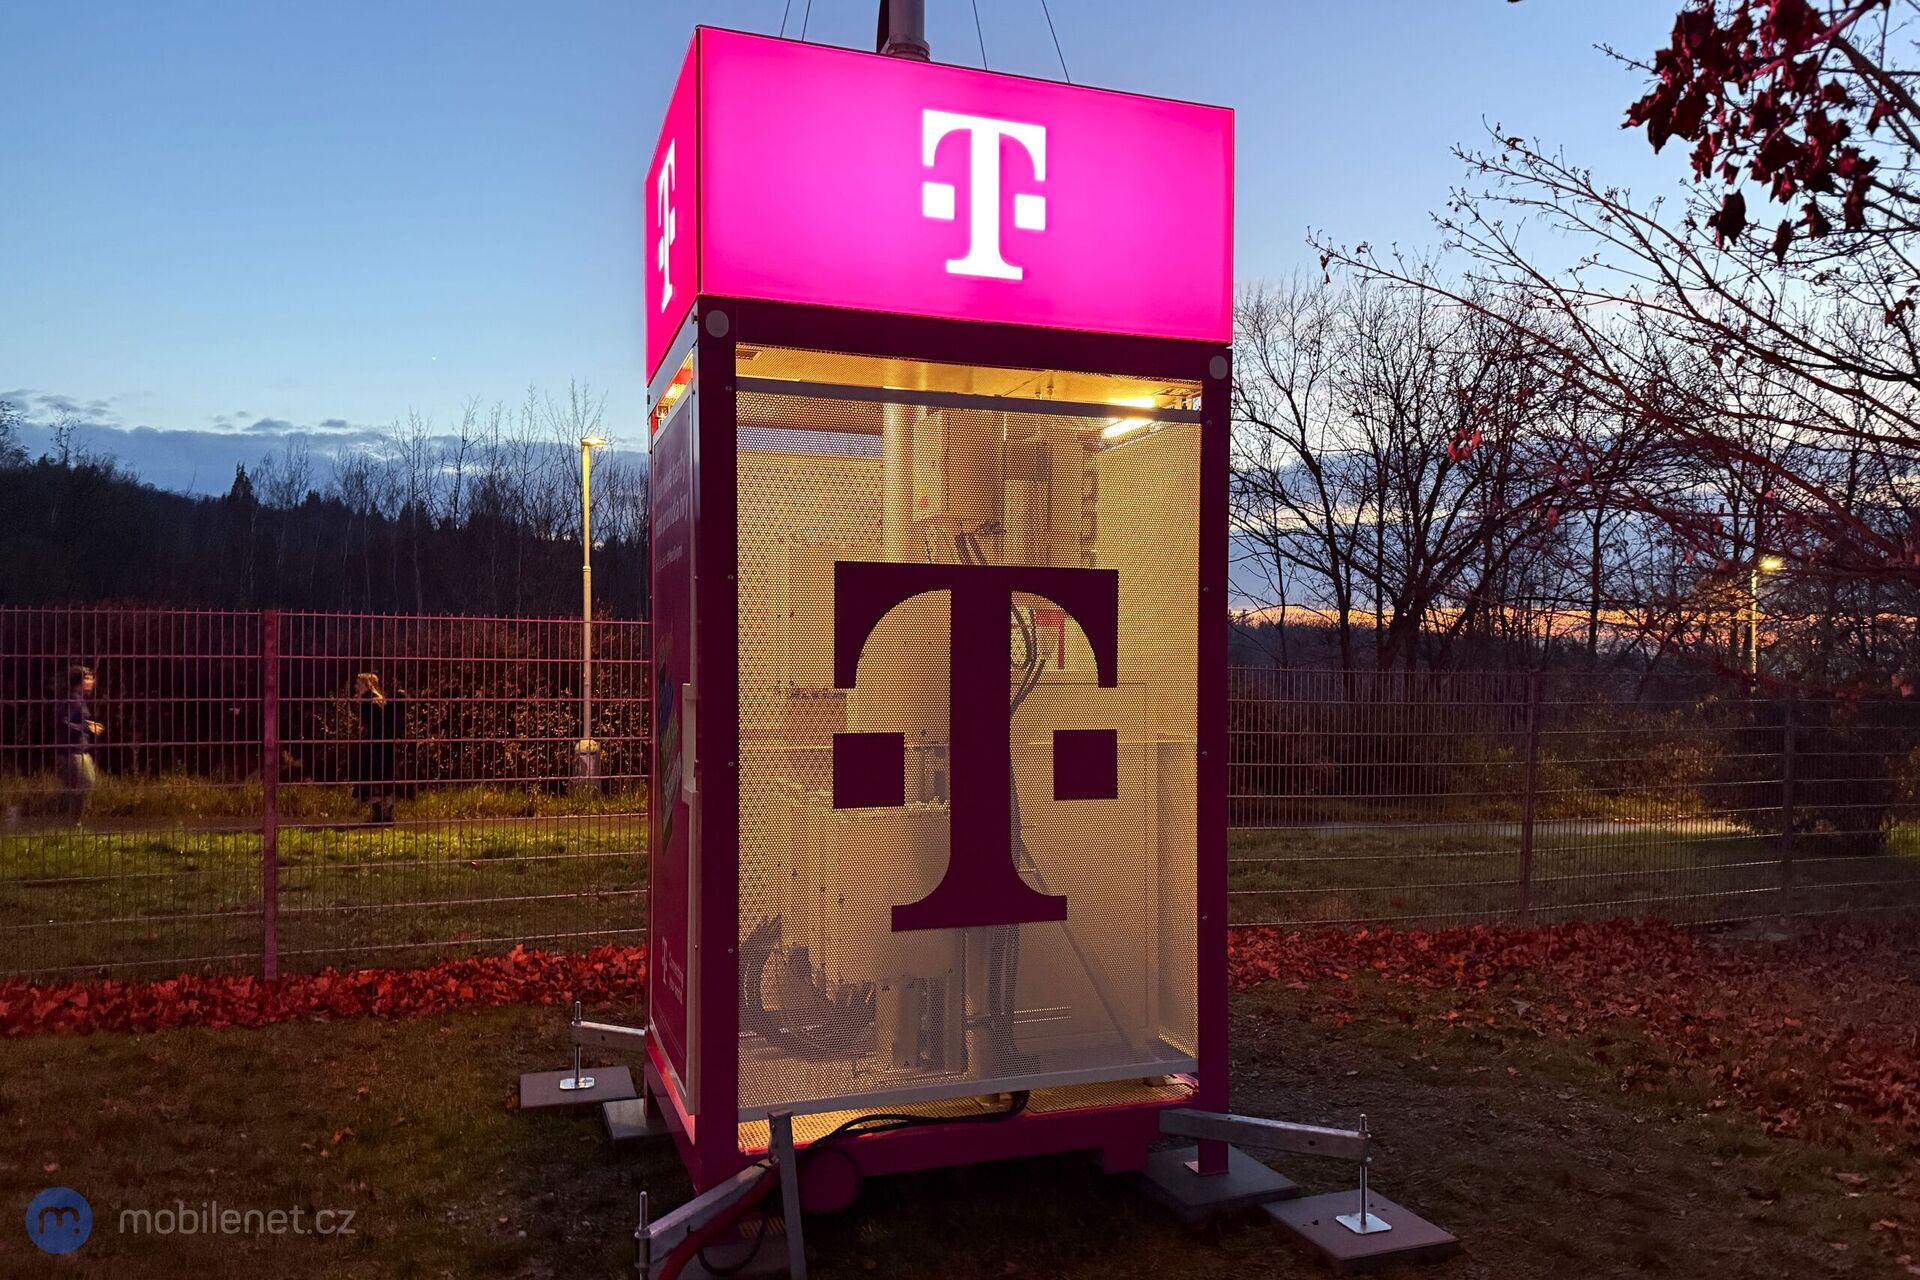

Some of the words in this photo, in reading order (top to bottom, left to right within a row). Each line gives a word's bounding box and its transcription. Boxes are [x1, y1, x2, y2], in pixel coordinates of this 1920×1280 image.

[658, 137, 676, 314] T
[922, 109, 1046, 281] T
[833, 560, 1119, 932] T
